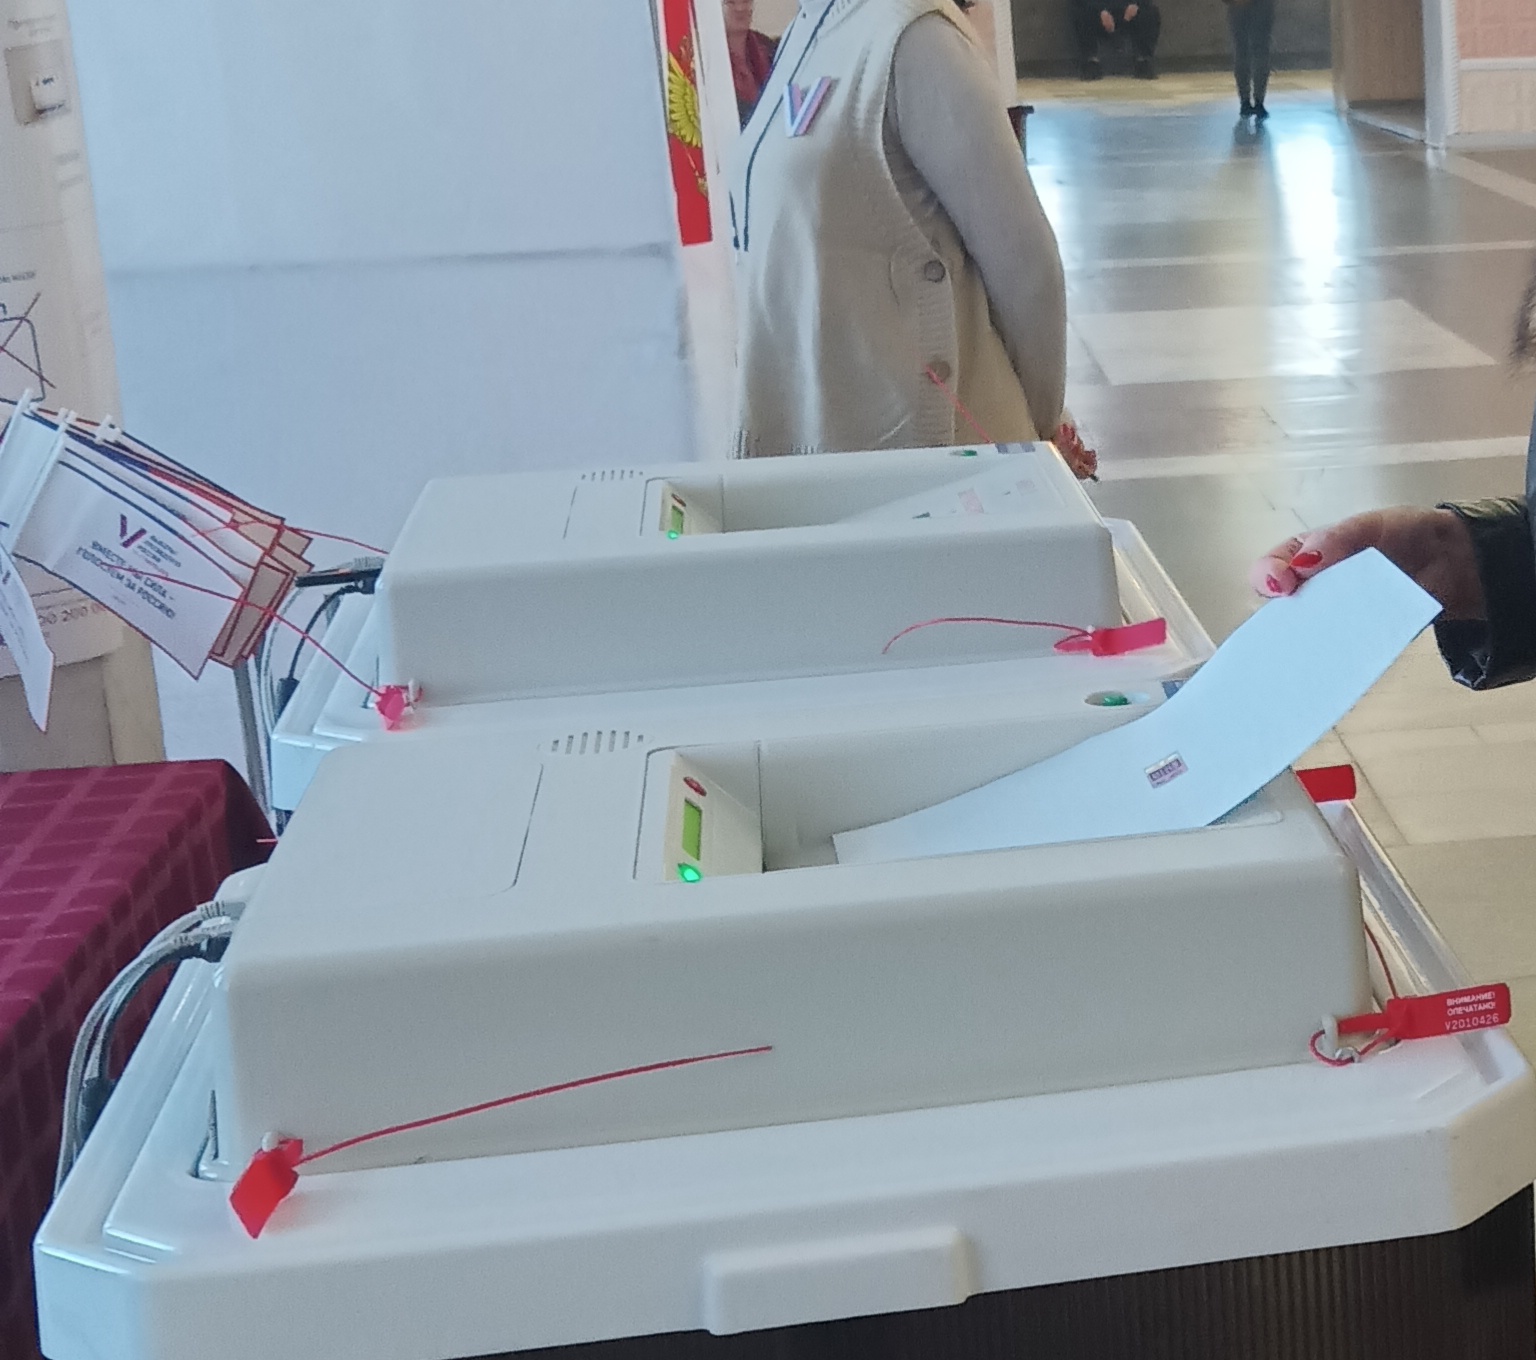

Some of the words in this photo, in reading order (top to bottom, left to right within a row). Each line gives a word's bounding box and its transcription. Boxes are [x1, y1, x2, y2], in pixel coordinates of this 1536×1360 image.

[1446, 991, 1496, 1007] ВНИМАНИЕ!
[1446, 1001, 1496, 1017] ОПЕЧАТАНО!
[1445, 1013, 1499, 1030] V2010426
